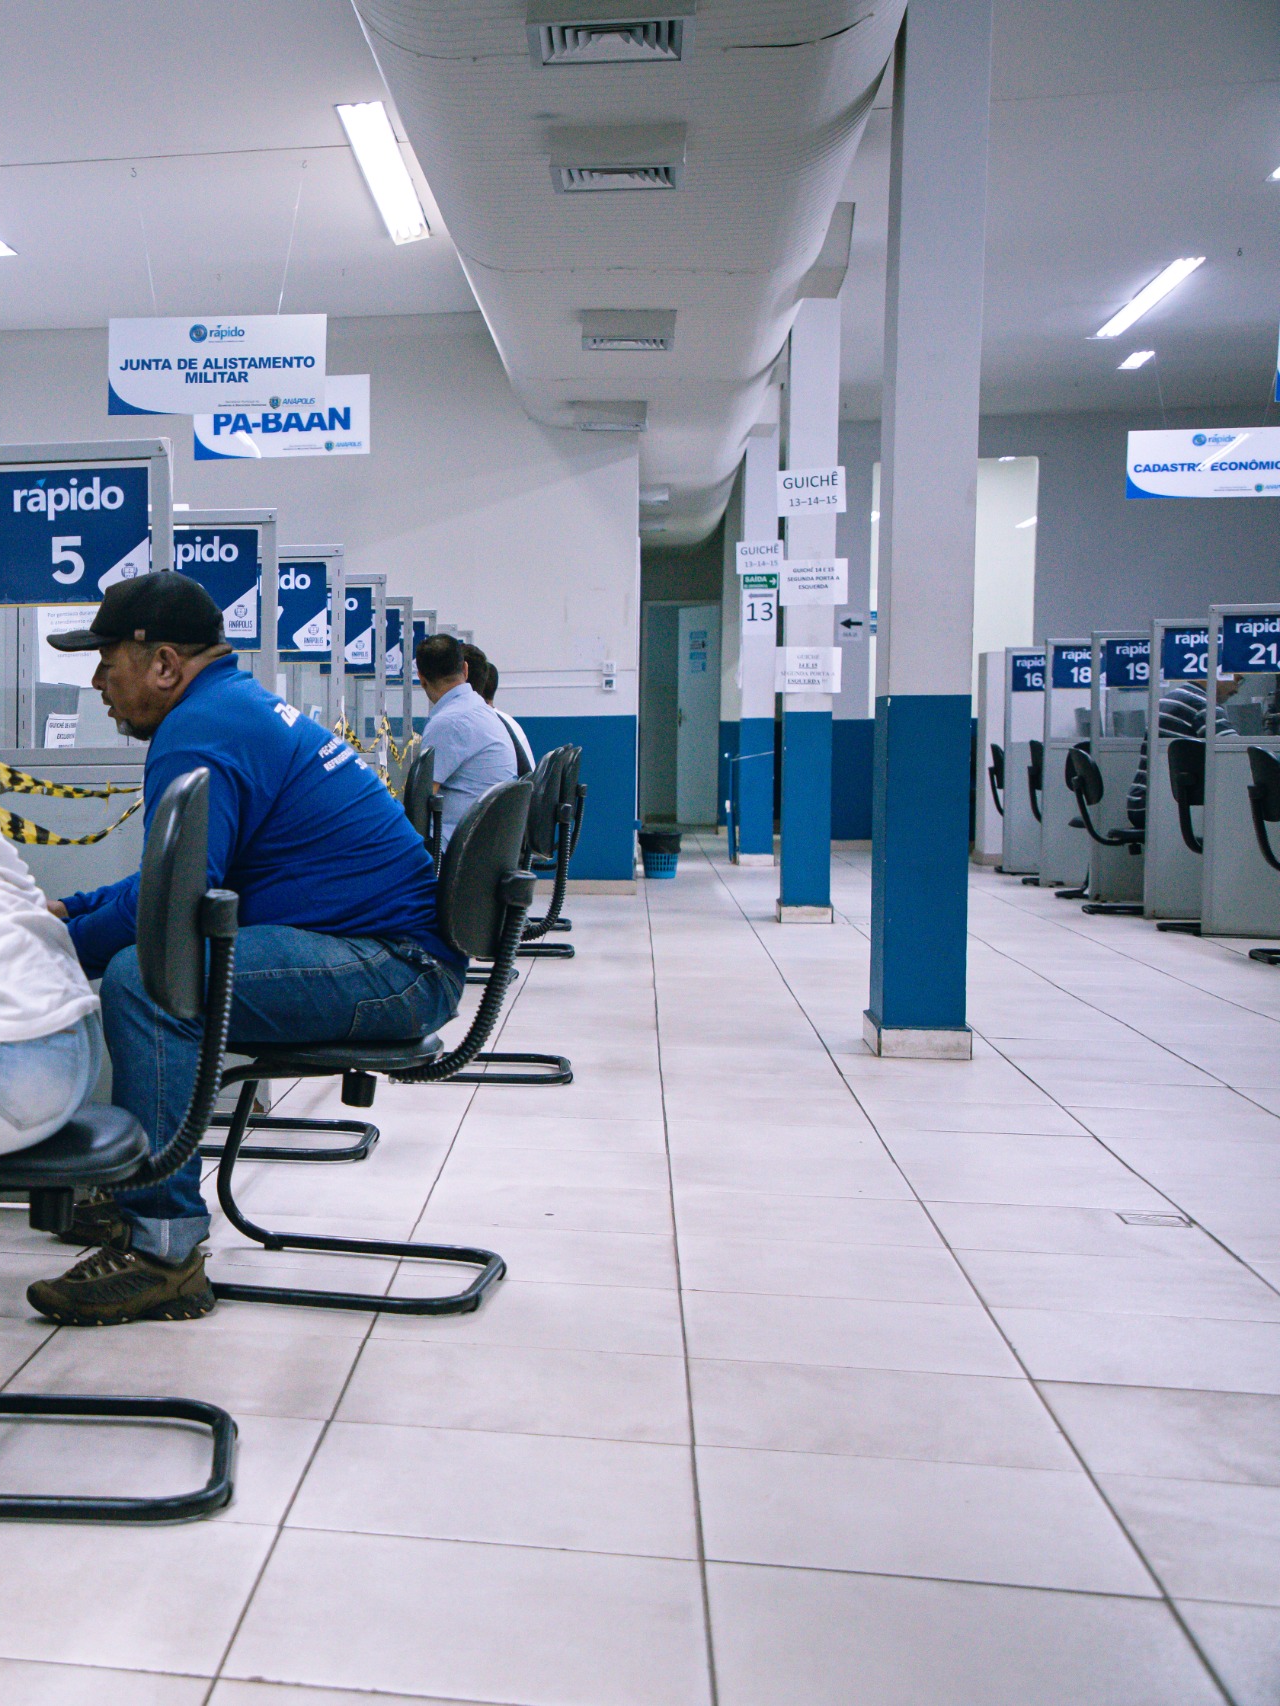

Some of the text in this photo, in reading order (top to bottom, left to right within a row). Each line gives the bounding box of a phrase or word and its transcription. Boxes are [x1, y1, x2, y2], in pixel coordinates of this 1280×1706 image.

[120, 355, 316, 371] JUNTA DE ALISTAMENTO
[185, 371, 249, 384] MILITAR
[213, 406, 351, 436] PA-BAAN
[1208, 434, 1236, 444] rápid
[1211, 459, 1280, 472] ECONÔMIC
[783, 471, 838, 489] GUICHÊ
[13, 477, 124, 521] rápido
[173, 536, 239, 570] pido
[740, 543, 779, 556] GUICHÊ
[52, 536, 85, 584] 5
[746, 602, 774, 622] 13
[1235, 617, 1280, 638] rápid
[1116, 642, 1150, 658] rápid
[1248, 642, 1277, 665] 21
[1016, 656, 1045, 669] rápid
[1126, 662, 1150, 681] 19
[1024, 672, 1043, 687] 16
[1070, 666, 1091, 684] 18
